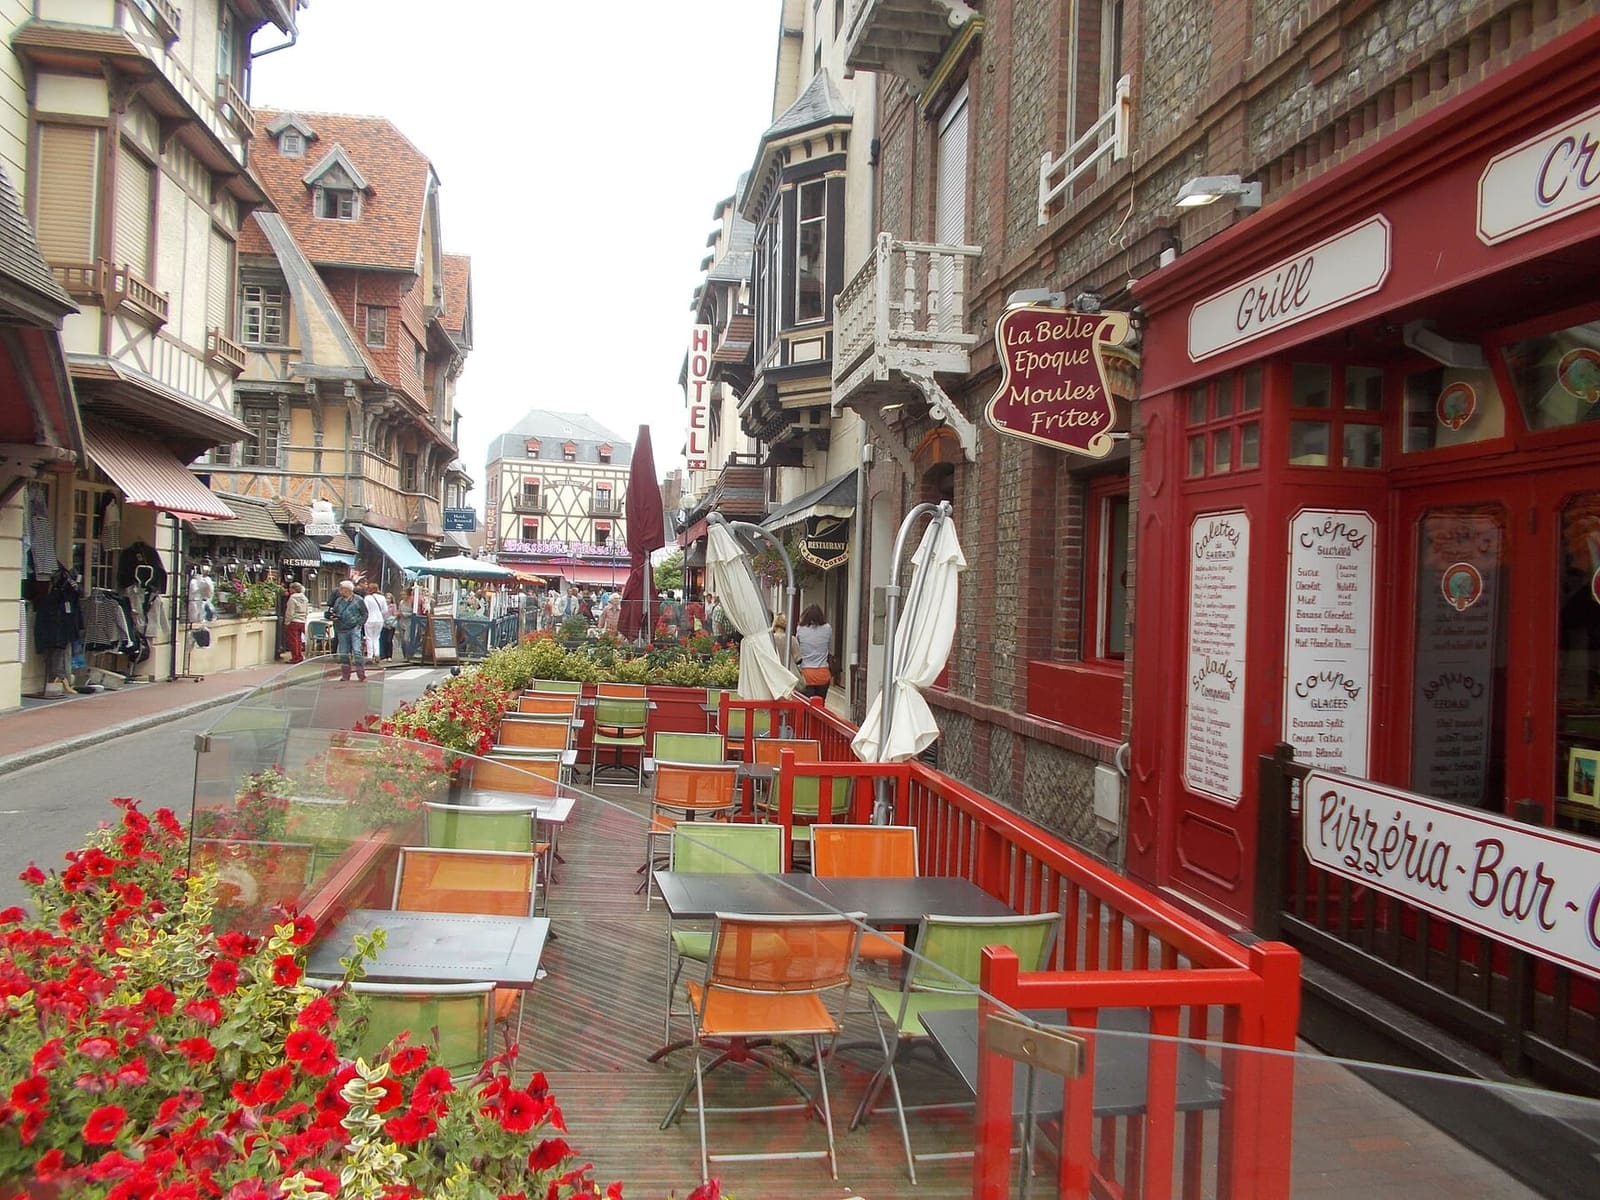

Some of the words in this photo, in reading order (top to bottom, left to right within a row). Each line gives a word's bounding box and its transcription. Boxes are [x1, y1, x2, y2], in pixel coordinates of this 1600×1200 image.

[1236, 255, 1315, 332] Grill
[1007, 326, 1033, 346] La
[1035, 316, 1094, 343] Belle
[1014, 348, 1090, 379] Epoque
[691, 328, 708, 455] HOTEL
[1008, 380, 1101, 406] Moules
[1030, 408, 1104, 434] Frites
[807, 541, 845, 550] RESTAURANT
[1195, 519, 1241, 558] Galettes
[1300, 516, 1367, 550] Crêpes
[815, 554, 847, 567] Bicorne
[1192, 655, 1238, 694] Salades
[1295, 671, 1361, 700] Coupes
